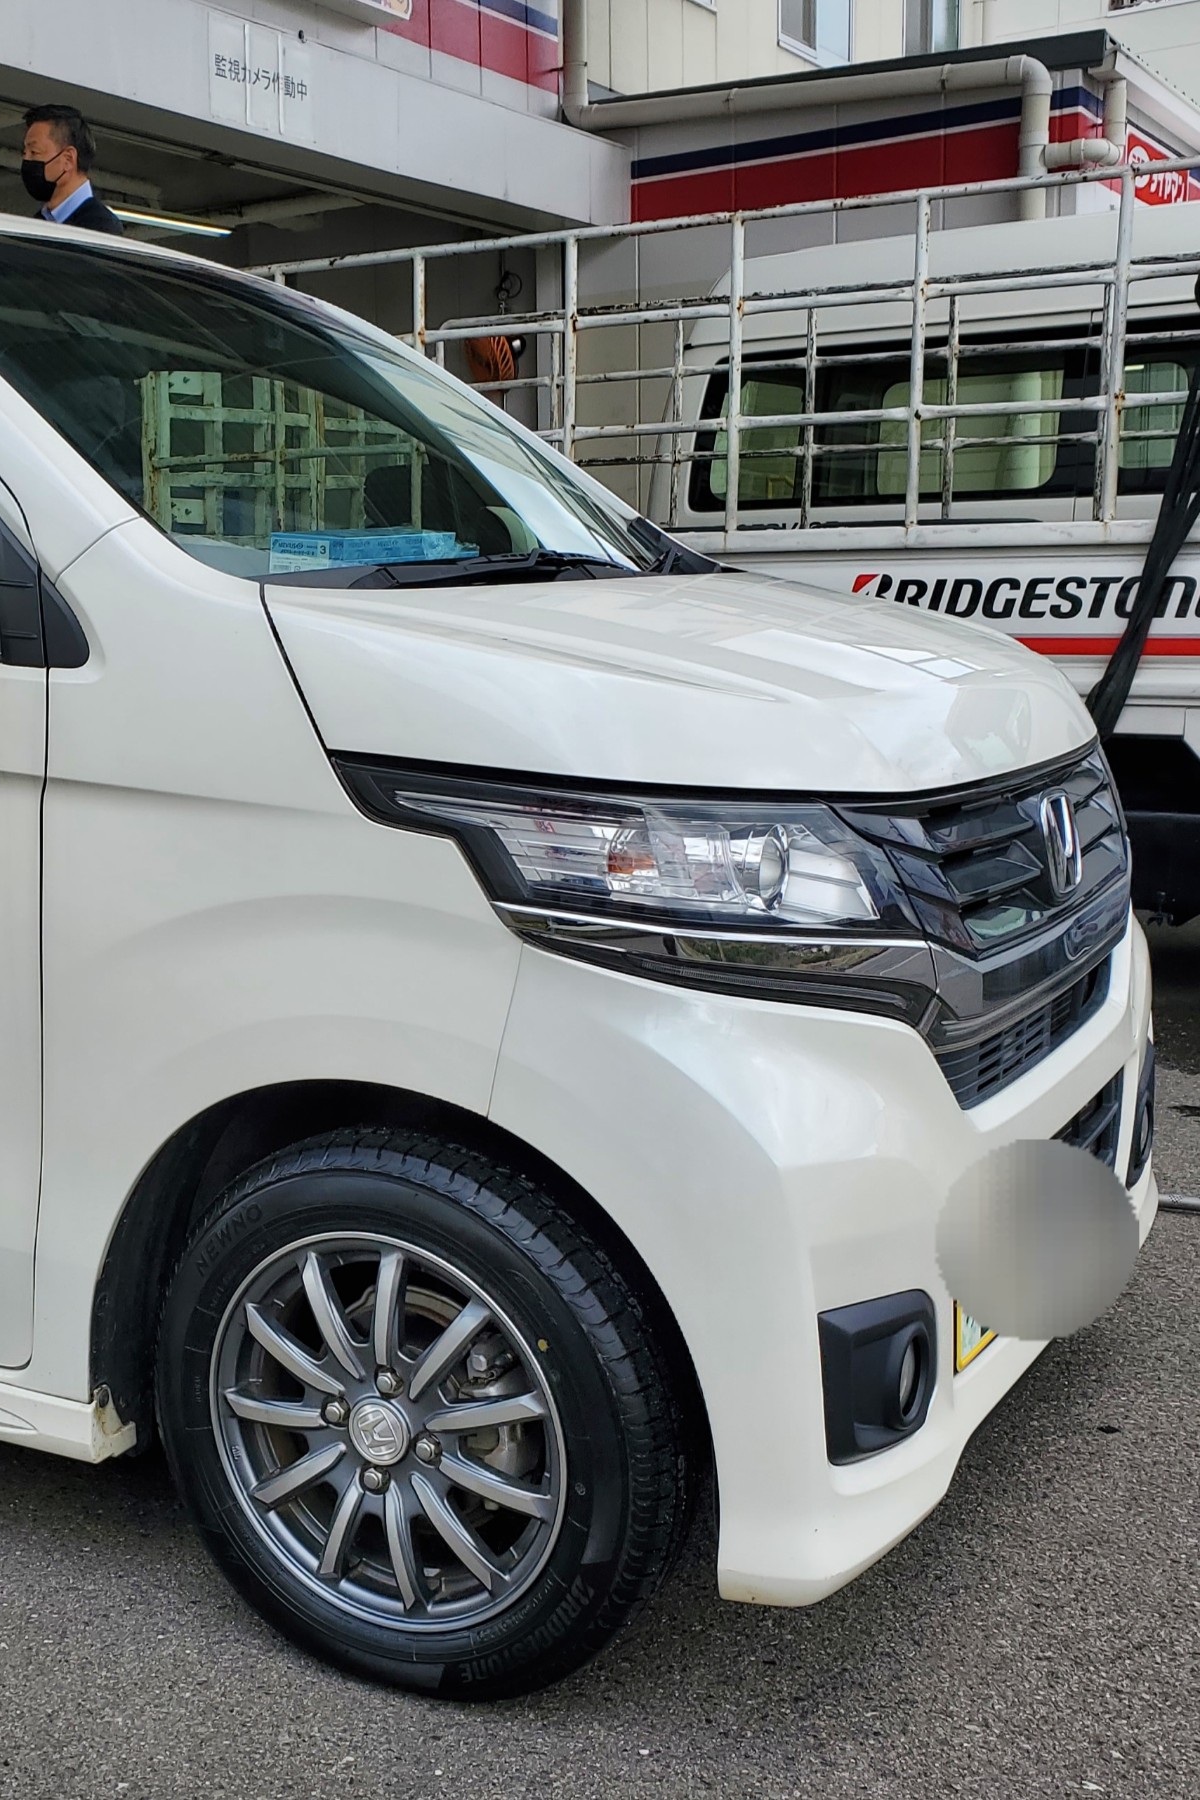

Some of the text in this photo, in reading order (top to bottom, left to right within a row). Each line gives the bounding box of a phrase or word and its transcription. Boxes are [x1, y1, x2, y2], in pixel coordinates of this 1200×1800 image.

[214, 53, 308, 101] 監視カメラ作動中
[319, 544, 327, 555] 3
[851, 573, 1200, 619] BRIDGESTON
[194, 1203, 264, 1278] NEWNO
